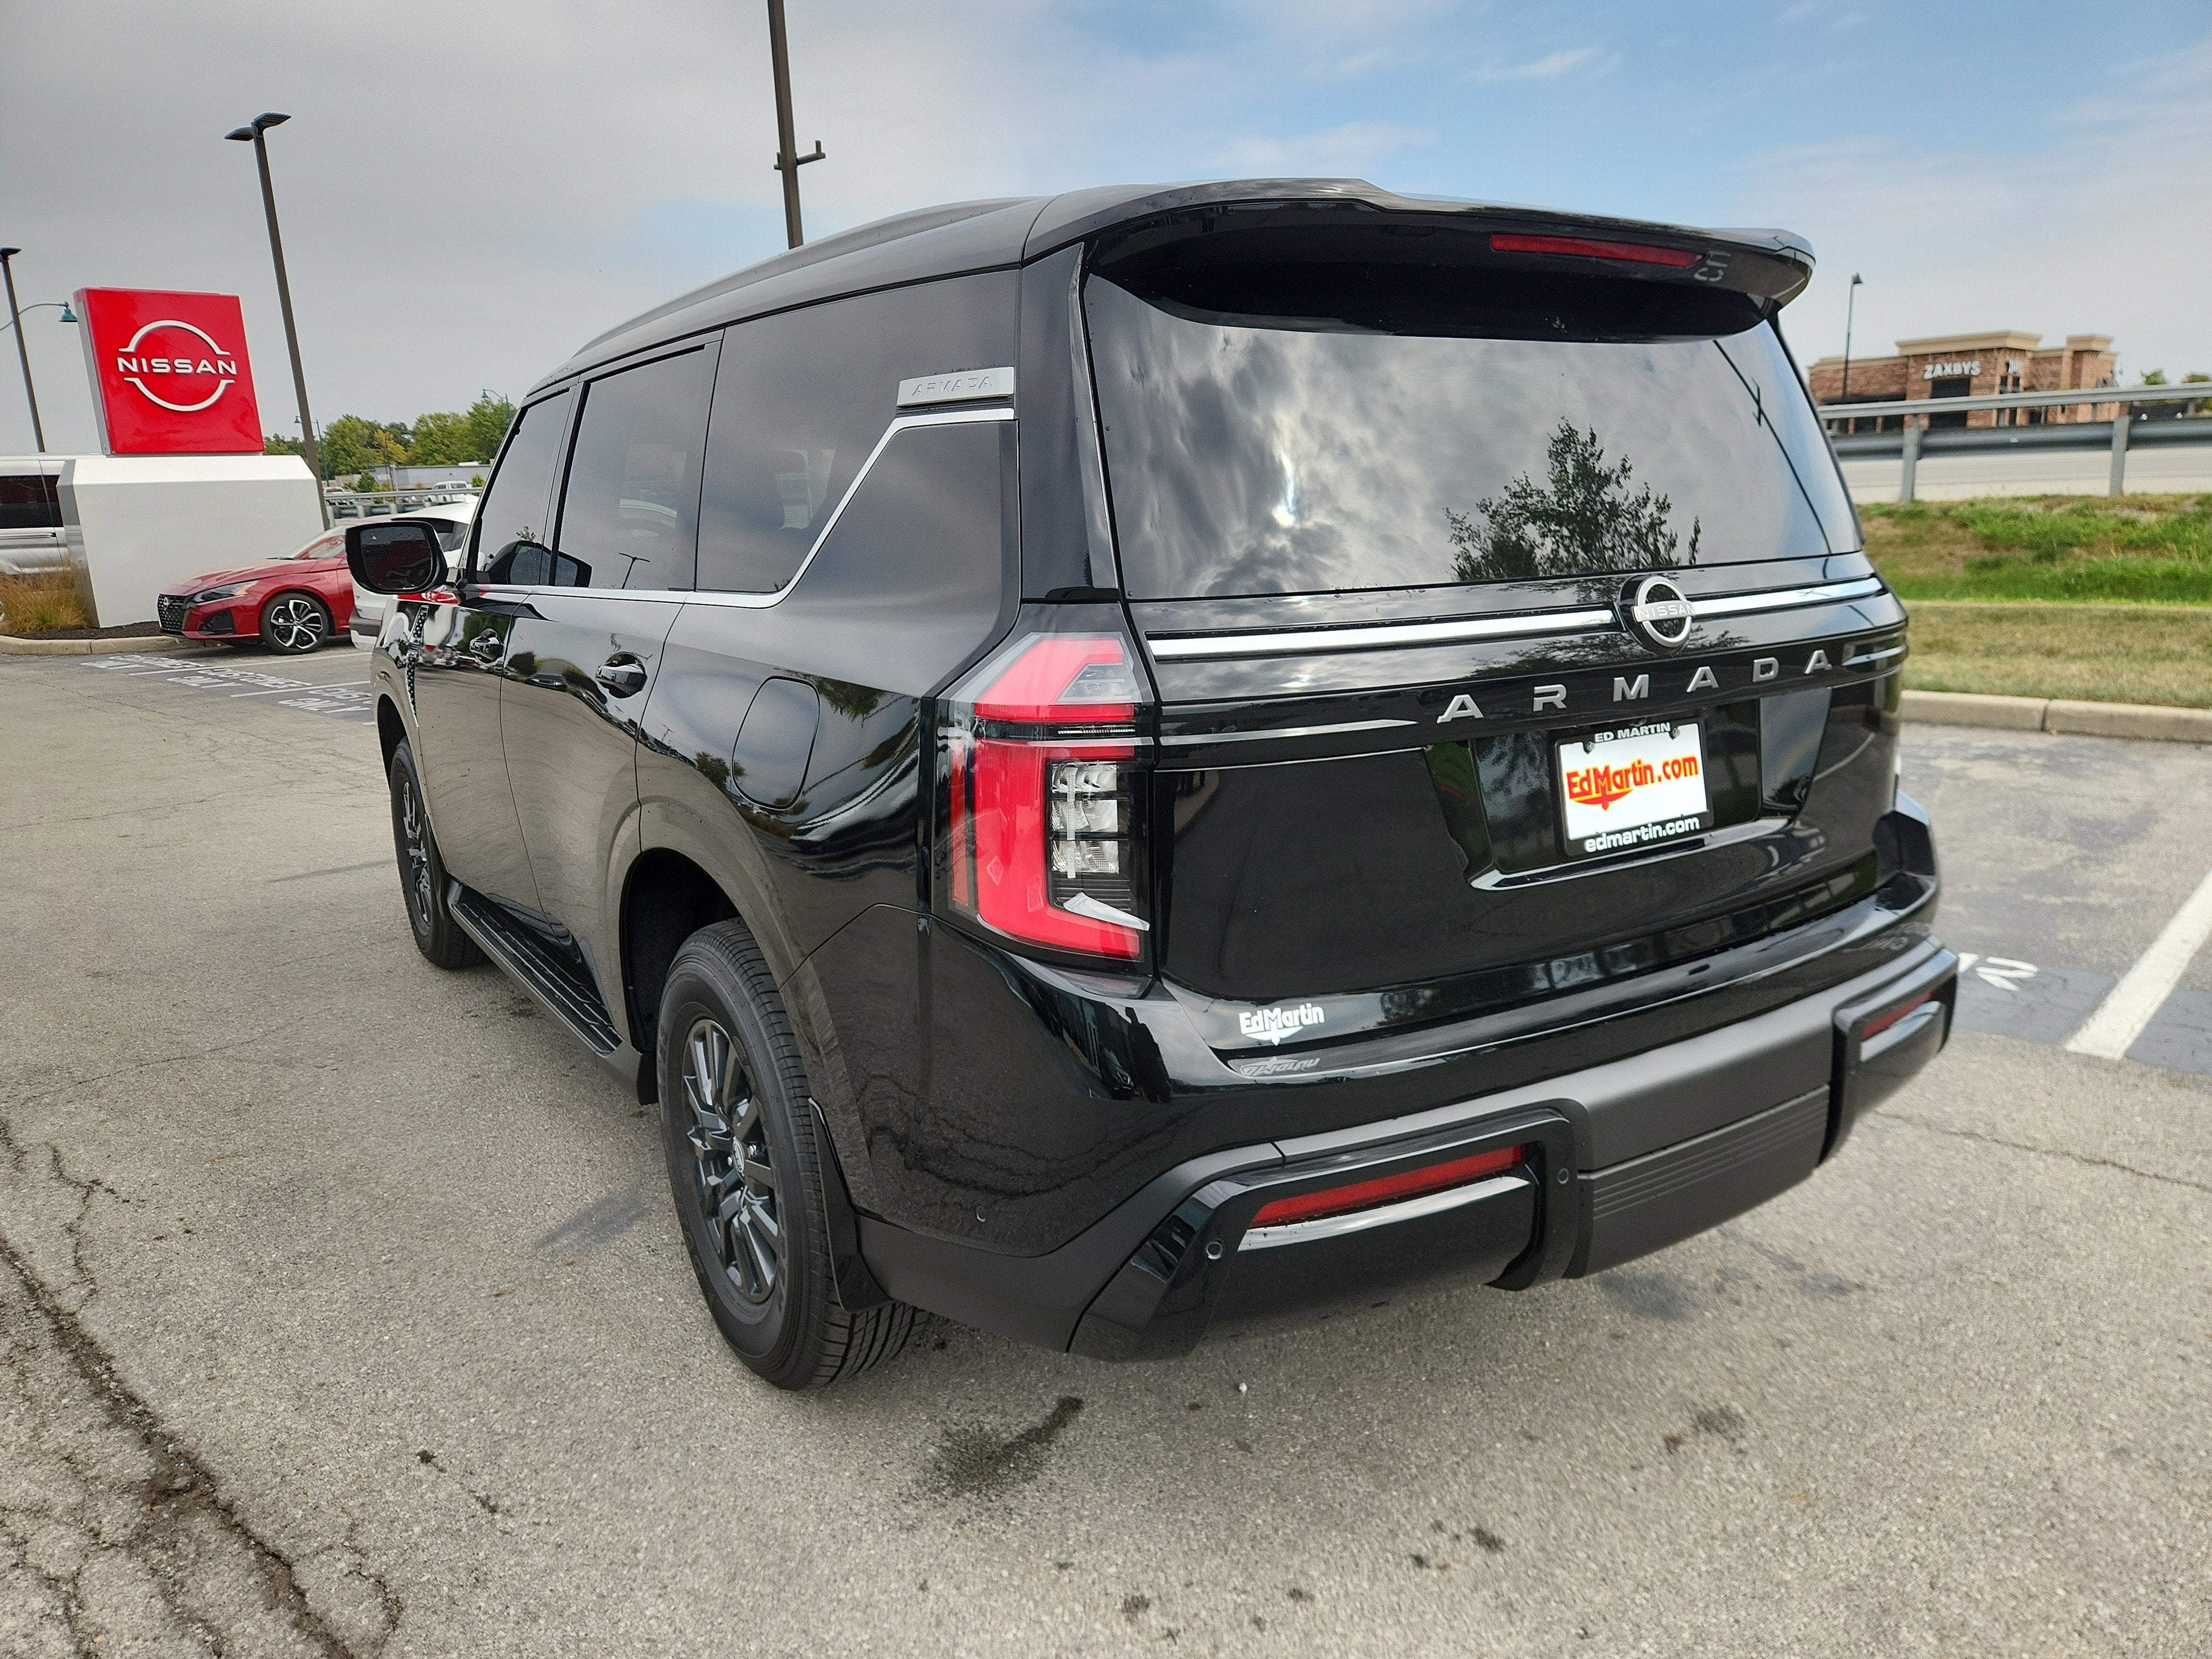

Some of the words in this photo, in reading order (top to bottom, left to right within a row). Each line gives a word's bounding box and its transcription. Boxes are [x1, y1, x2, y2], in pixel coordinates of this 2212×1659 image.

[117, 357, 237, 375] NISSAN
[1923, 361, 1981, 380] ZAXBYS
[912, 376, 993, 396] ARMADA
[1637, 603, 1695, 620] NISSAN
[1436, 648, 1833, 724] ARMADA
[1594, 731, 1615, 743] ED
[1617, 722, 1671, 740] MARTIN
[1584, 816, 1700, 853] edmartin.com
[1239, 1003, 1325, 1036] EdMartin
